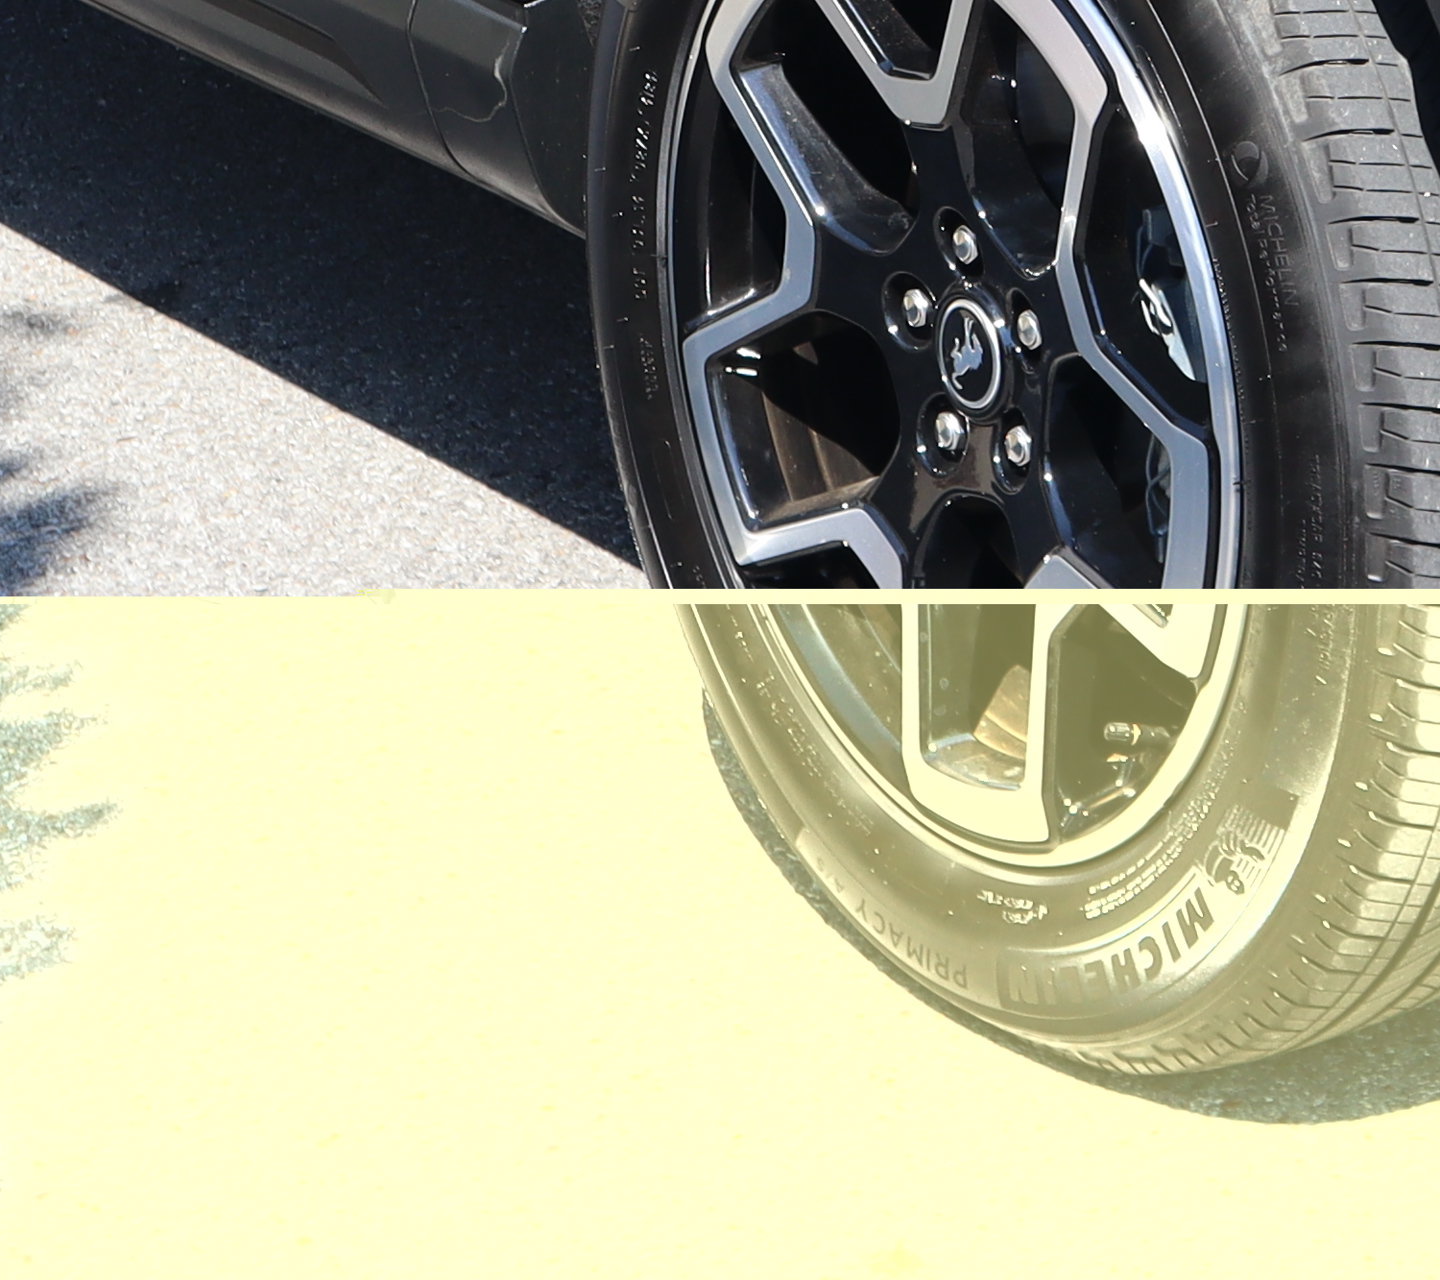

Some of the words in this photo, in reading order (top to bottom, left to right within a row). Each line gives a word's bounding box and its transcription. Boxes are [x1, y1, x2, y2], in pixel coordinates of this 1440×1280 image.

[1259, 194, 1300, 307] MICHELIN
[855, 897, 968, 990] PRIMACY
[1008, 886, 1215, 1006] MICHELIN
